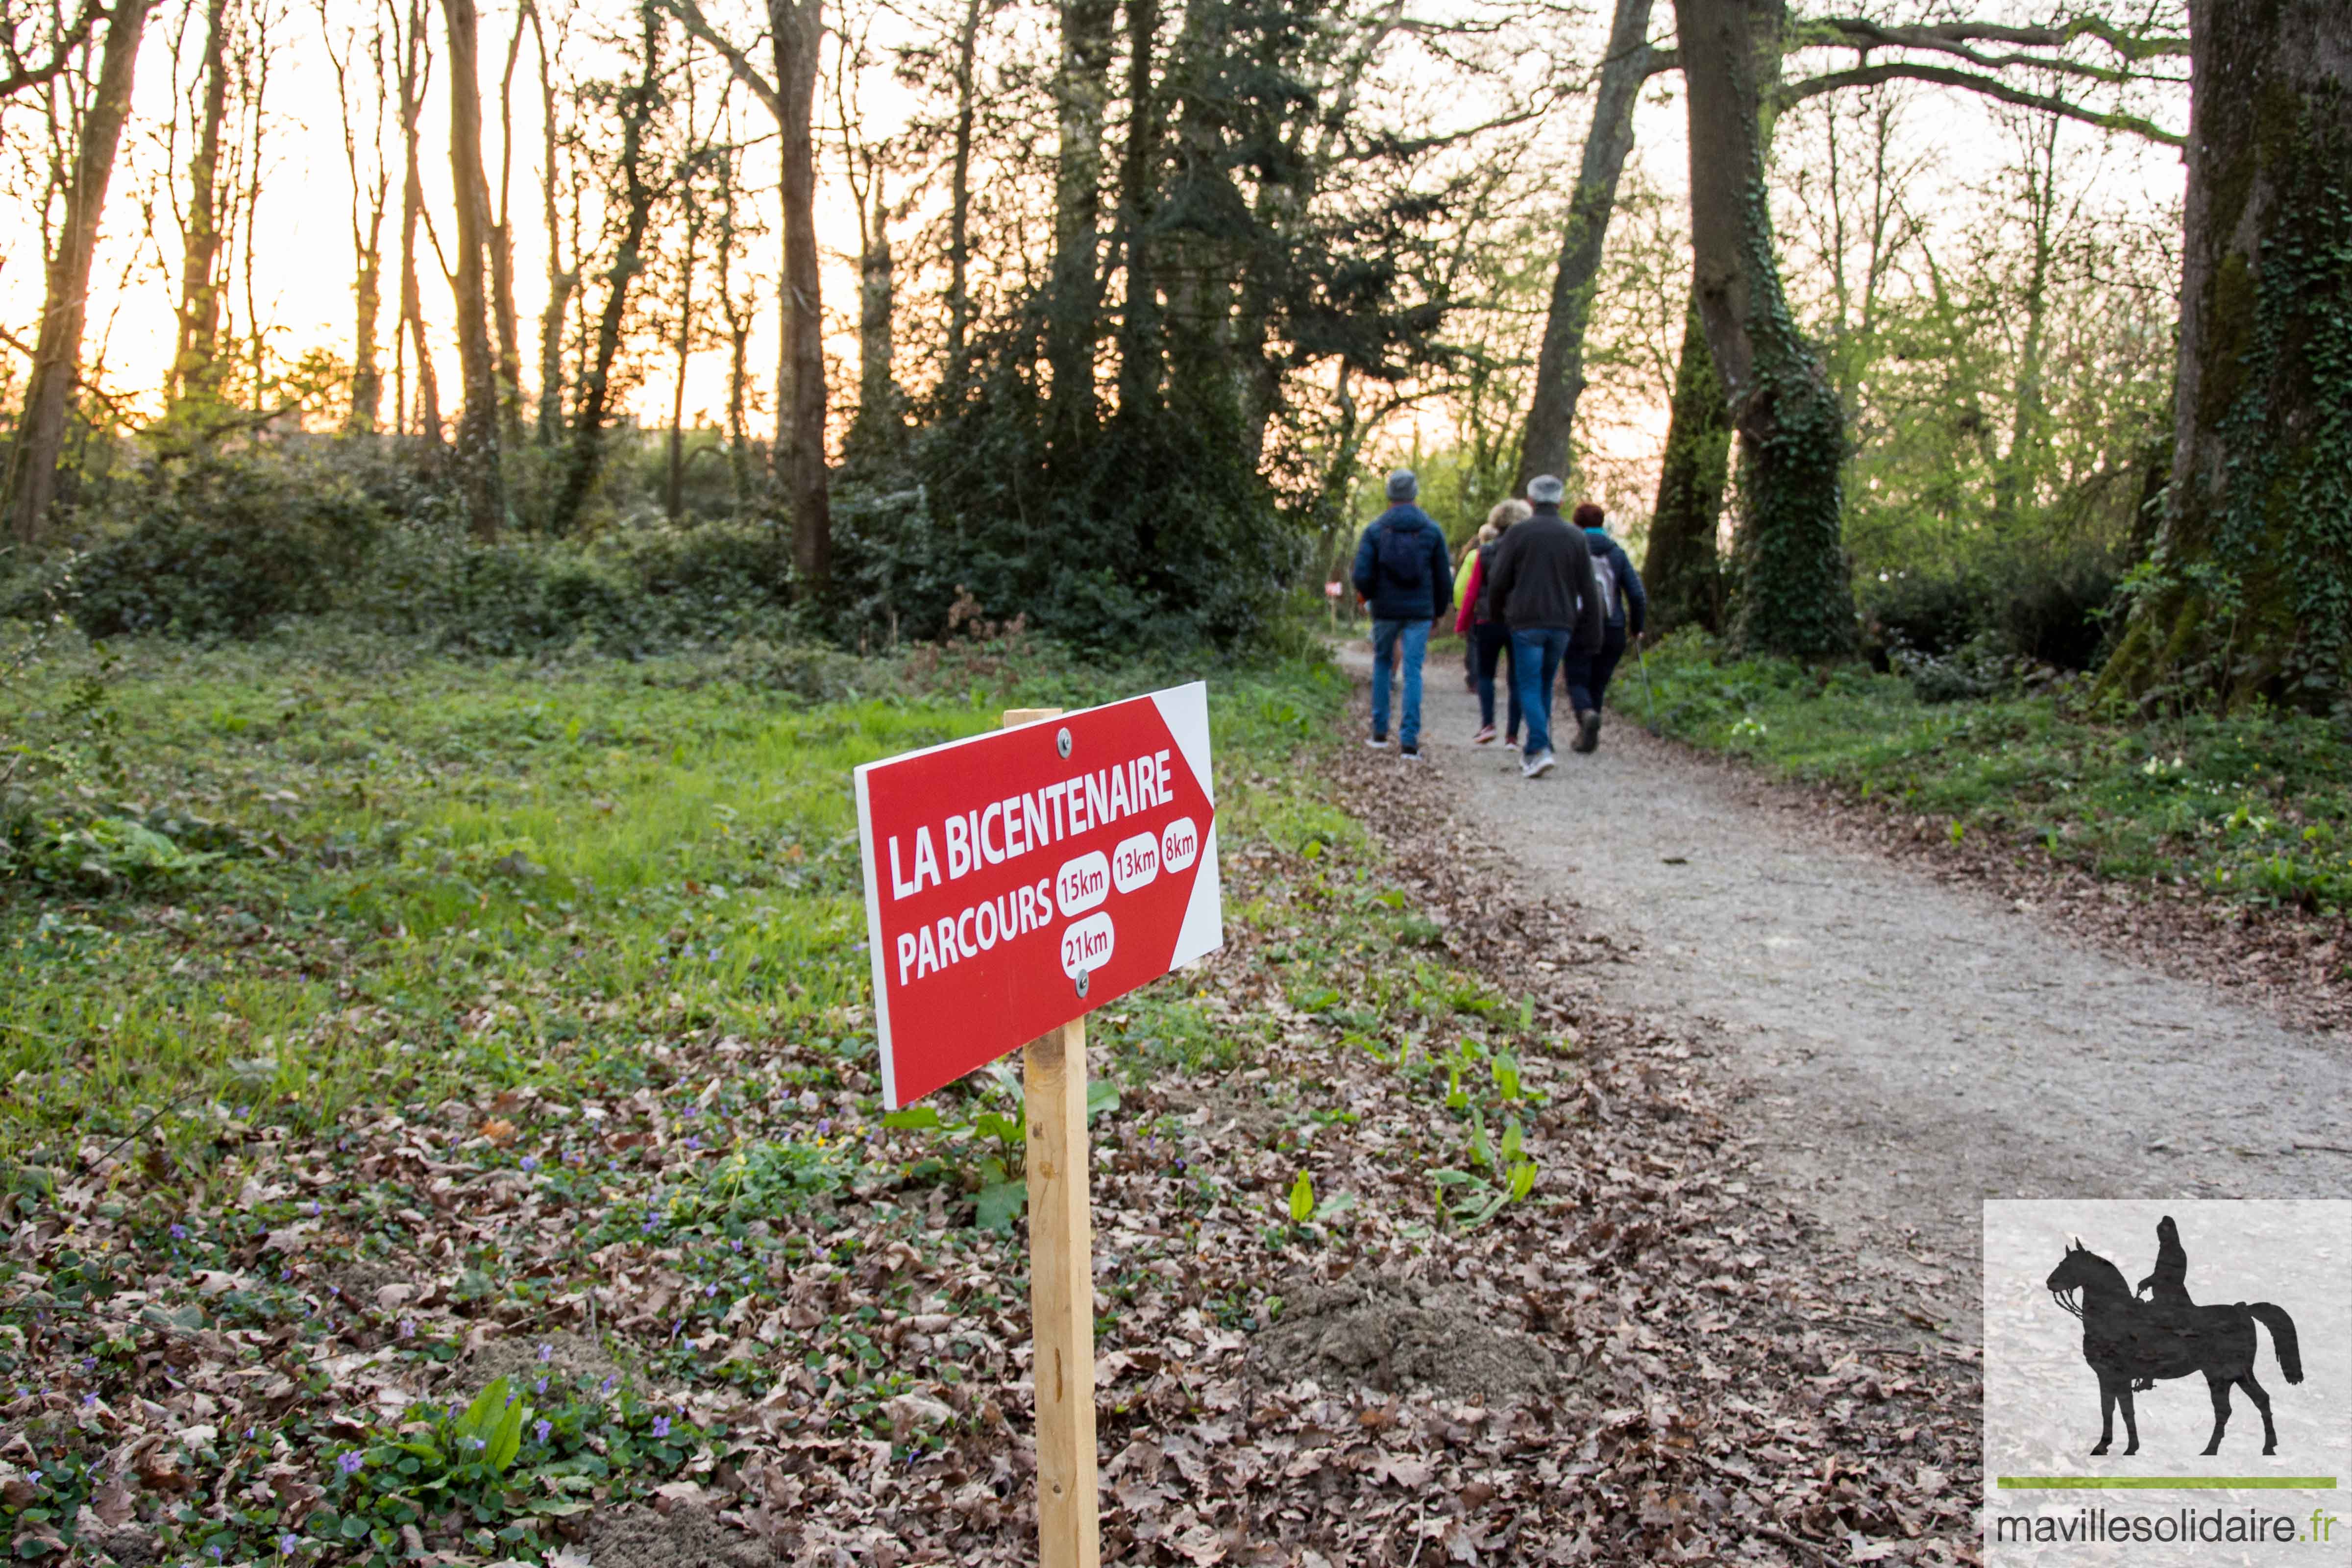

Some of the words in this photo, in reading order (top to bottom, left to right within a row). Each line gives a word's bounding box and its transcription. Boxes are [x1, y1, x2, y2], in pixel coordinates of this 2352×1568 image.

[889, 826, 941, 900] LA
[945, 749, 1173, 880] BICENTENAIRE
[897, 879, 1053, 986] PARCOURS
[1061, 869, 1103, 903] 15km
[1117, 847, 1155, 881] 13km
[1166, 832, 1194, 861] 8km
[1065, 931, 1107, 966] 21km
